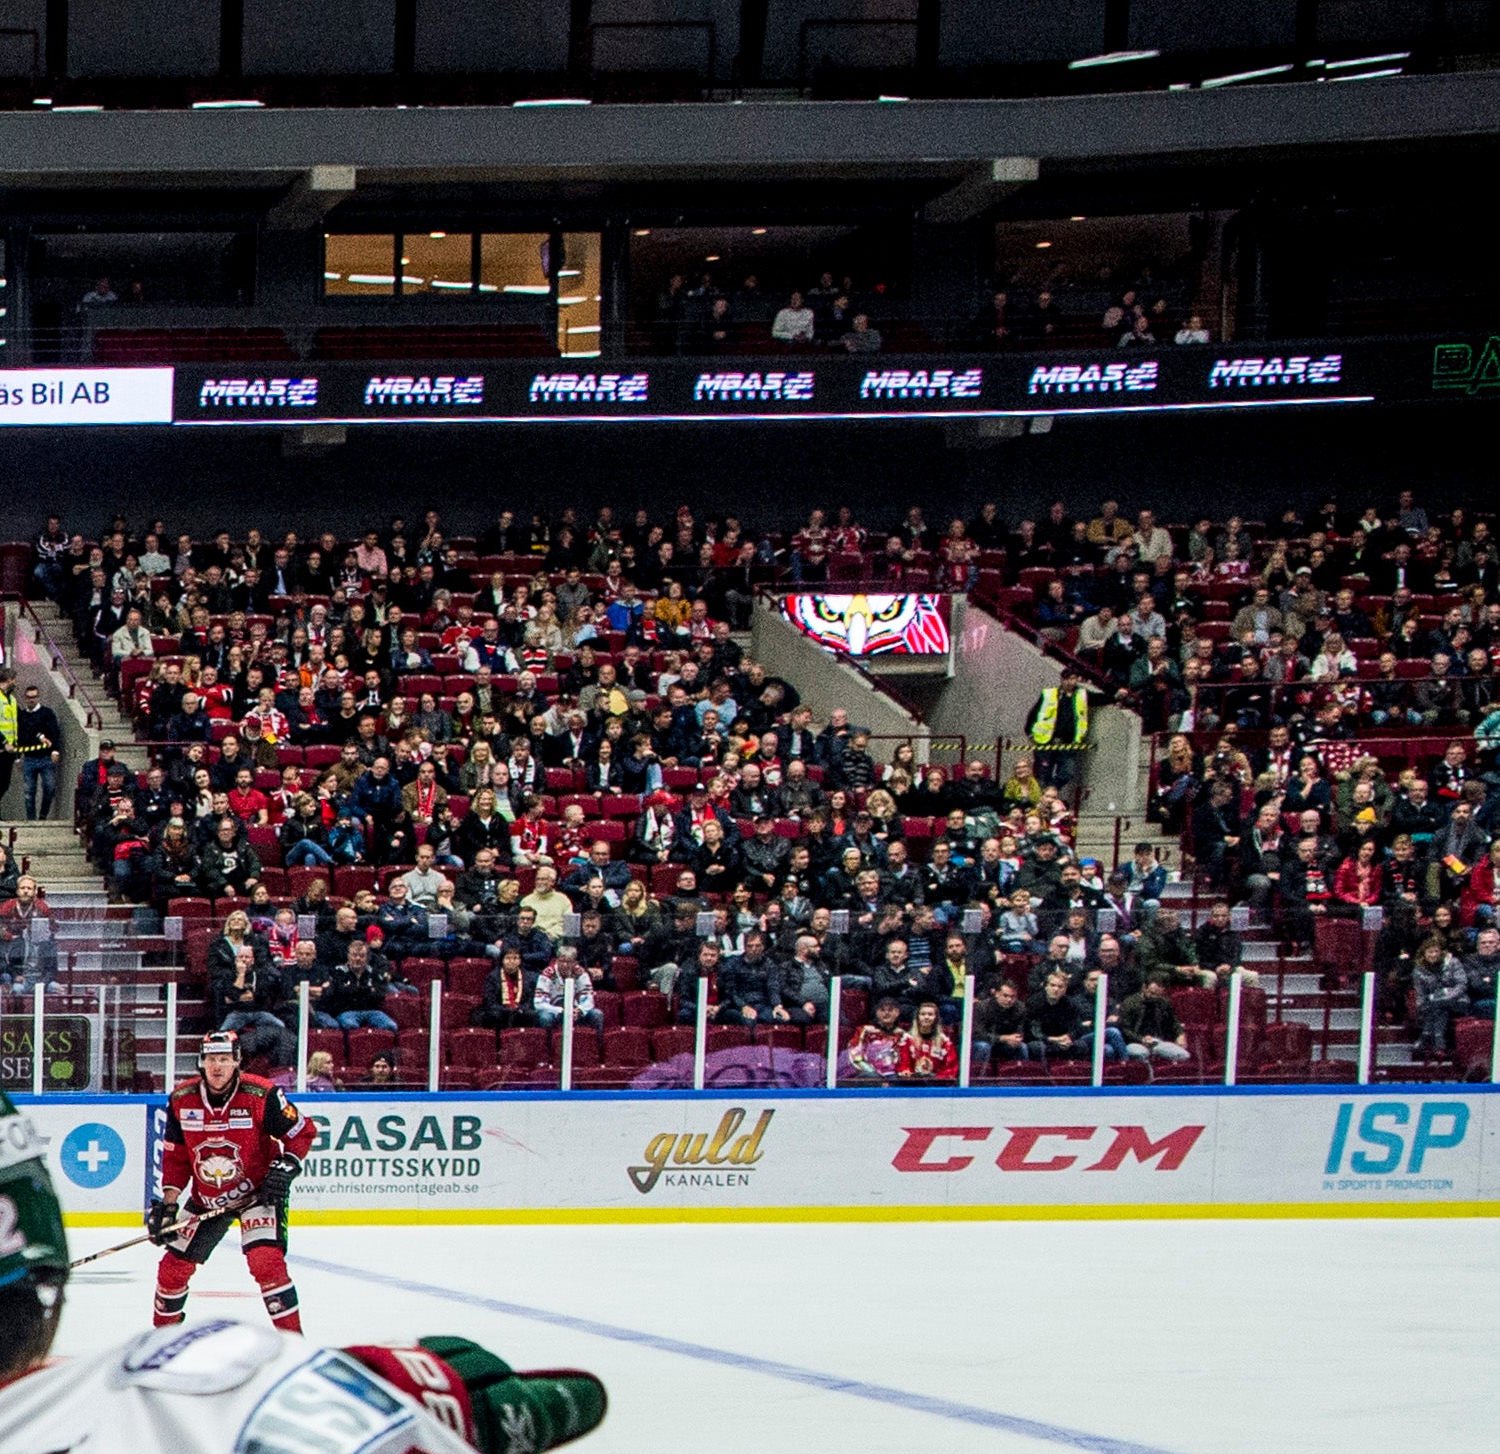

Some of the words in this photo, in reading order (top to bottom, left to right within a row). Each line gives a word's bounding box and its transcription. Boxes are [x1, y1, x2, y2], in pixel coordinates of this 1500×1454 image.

[31, 381, 64, 406] Bil
[70, 382, 110, 405] AB
[890, 1124, 1207, 1172] CCM
[1324, 1101, 1471, 1175] ISP
[628, 1107, 776, 1195] guld
[303, 1158, 481, 1178] NBROTTSSKYDD
[295, 1182, 479, 1197] www.christersmontageab.se
[665, 1174, 750, 1187] KANALEN
[1323, 1180, 1336, 1190] IN
[1338, 1180, 1382, 1191] SPORTS
[1386, 1180, 1454, 1191] PROMOTION
